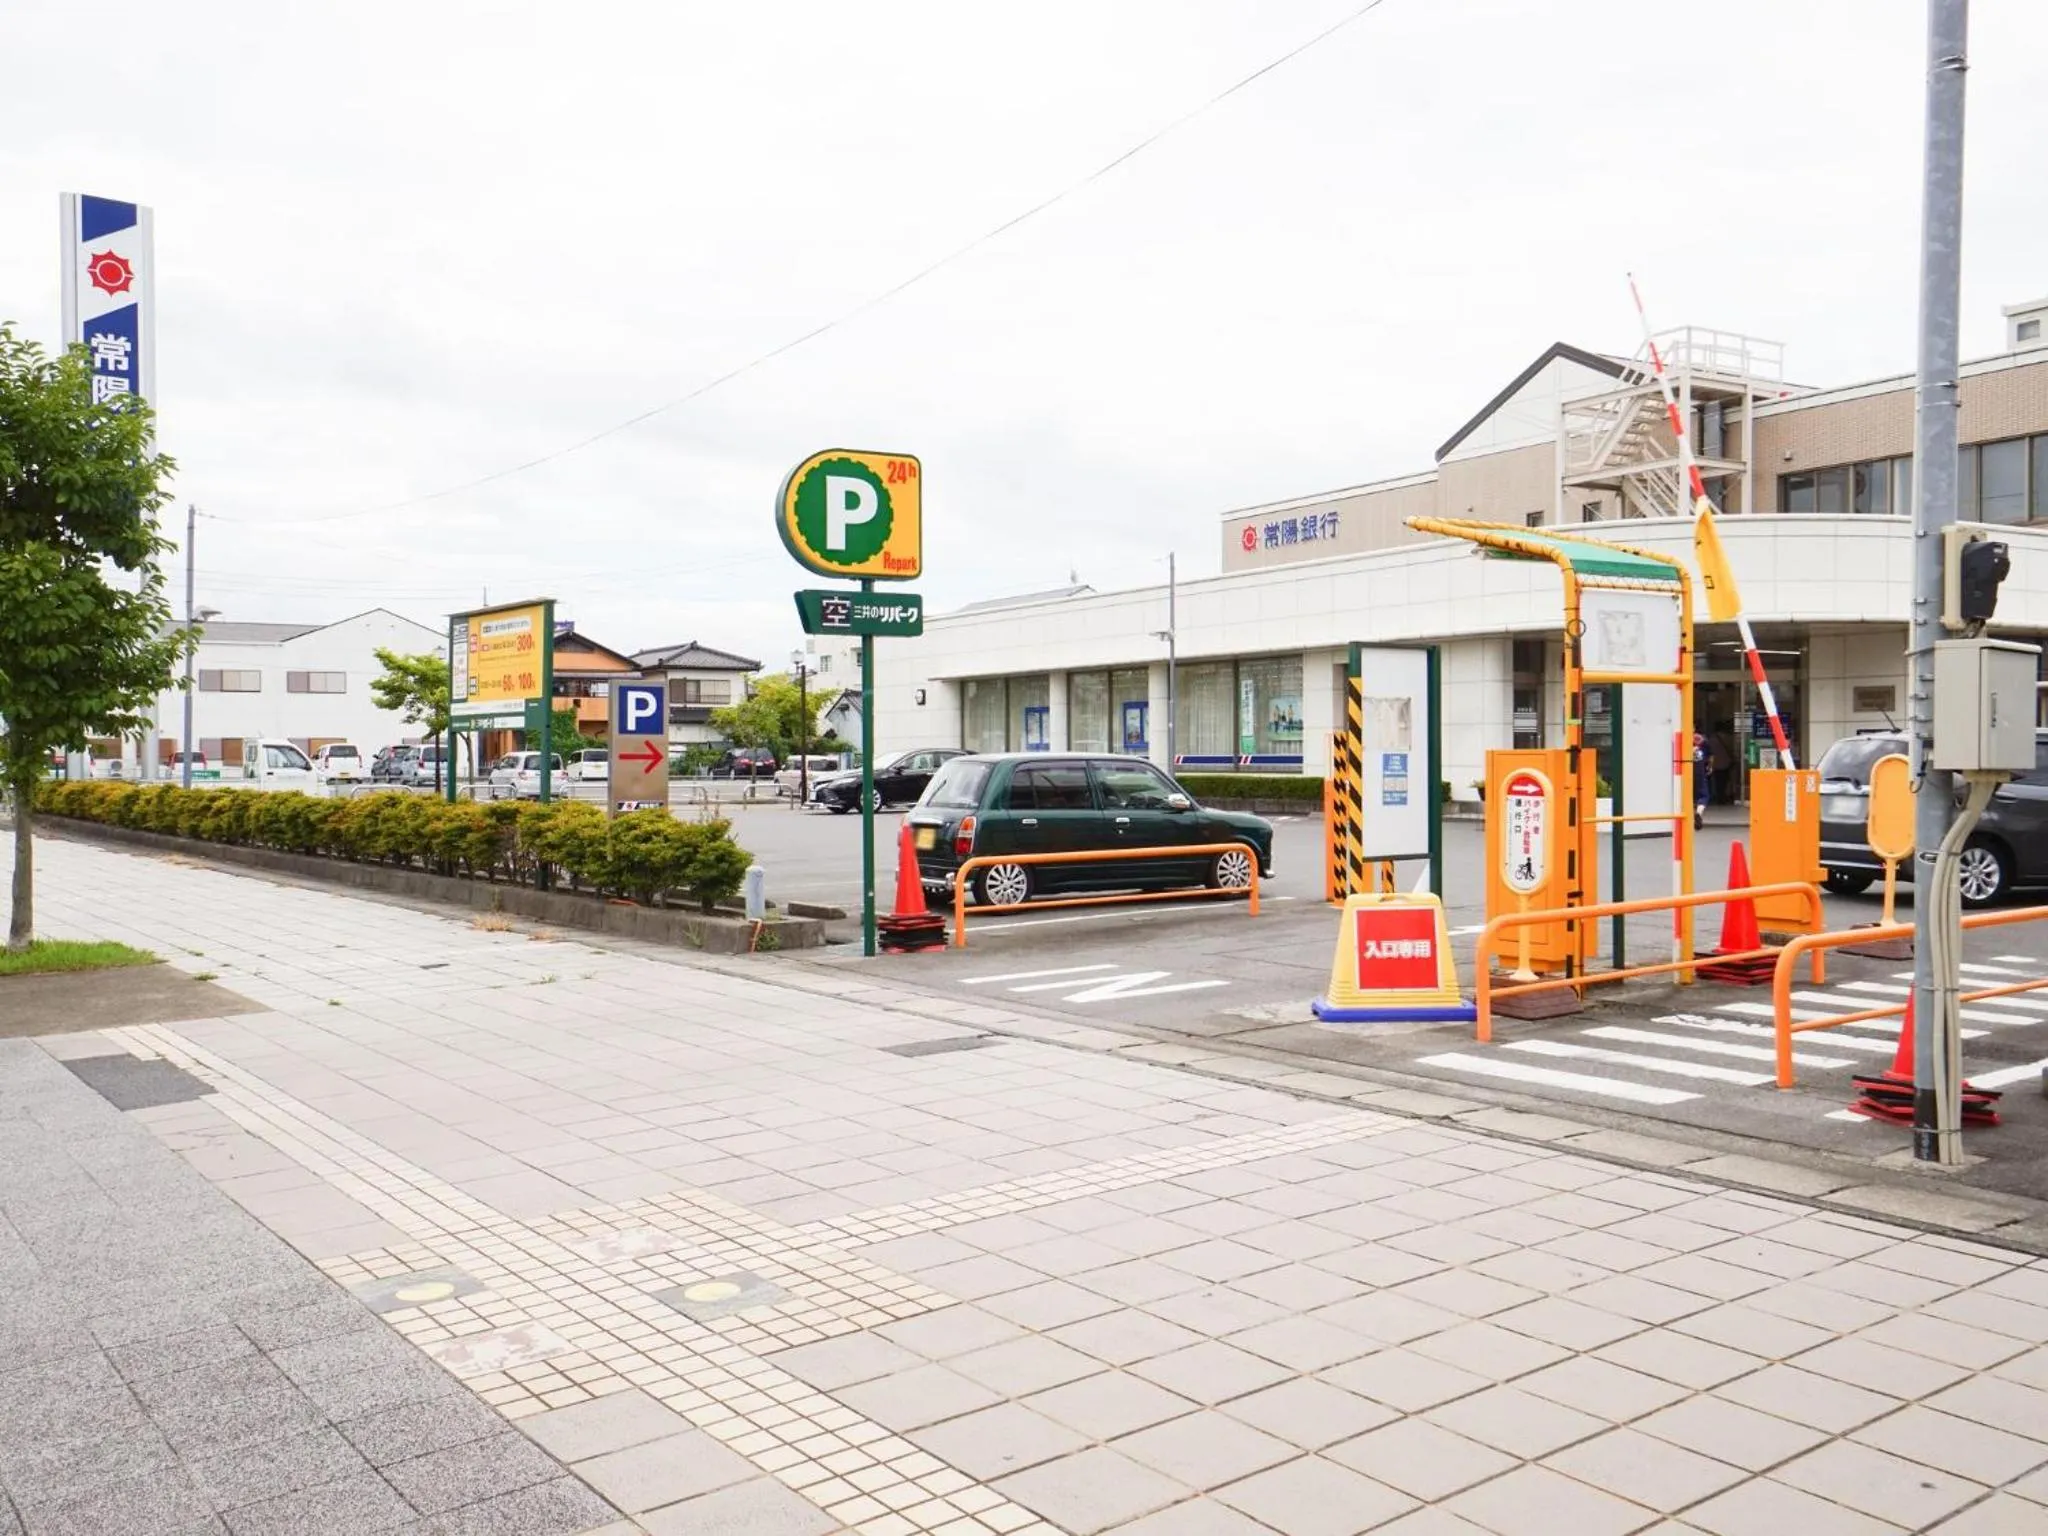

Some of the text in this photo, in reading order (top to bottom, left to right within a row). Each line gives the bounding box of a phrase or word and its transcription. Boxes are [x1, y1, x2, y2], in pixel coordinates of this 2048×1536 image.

[888, 460, 917, 484] 24h
[826, 475, 878, 550] P
[1264, 511, 1340, 549] 常陽銀行
[883, 551, 917, 572] Repark
[822, 596, 851, 627] 空
[853, 605, 919, 623] 三井のリパーク
[627, 691, 657, 731] P
[1364, 939, 1431, 959] 入口専用
